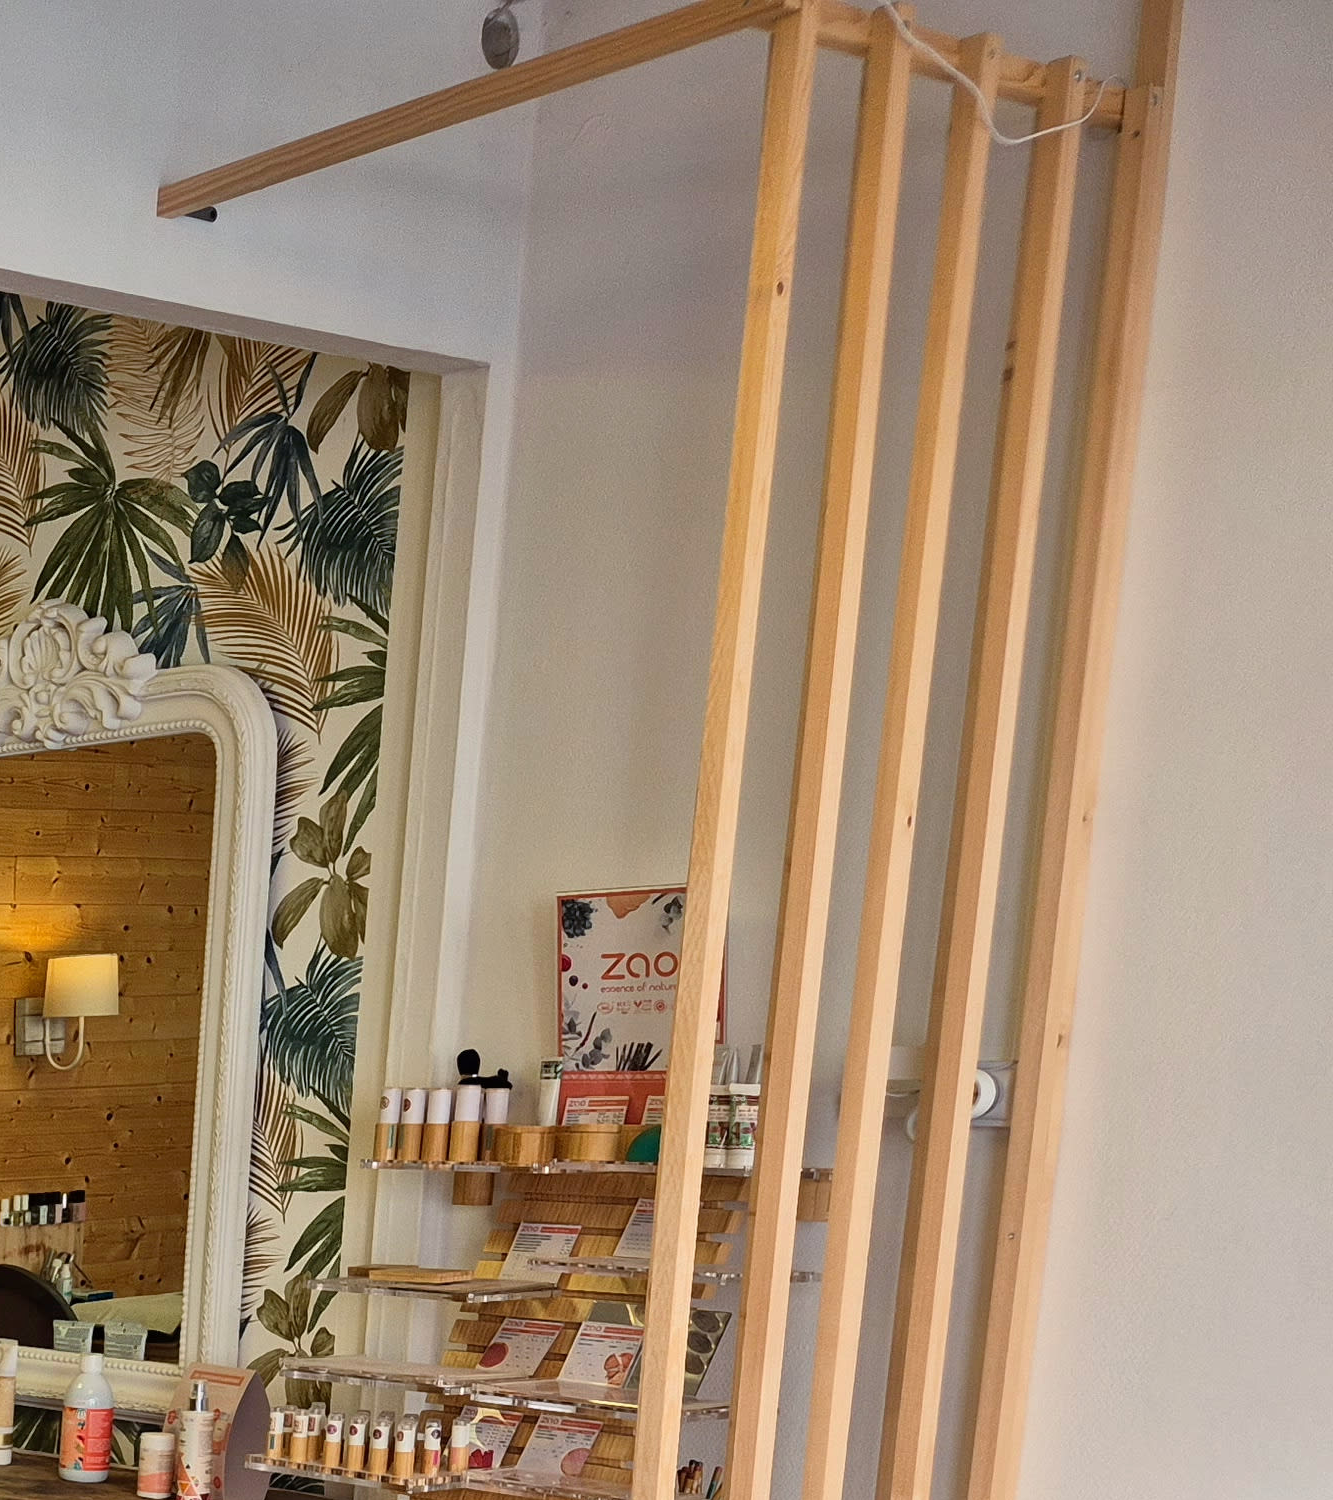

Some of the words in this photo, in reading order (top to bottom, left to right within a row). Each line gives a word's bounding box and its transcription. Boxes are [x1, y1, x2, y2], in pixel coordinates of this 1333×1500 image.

[600, 951, 679, 980] zao
[600, 985, 634, 993] essence
[636, 982, 646, 992] of
[648, 981, 677, 992] natur
